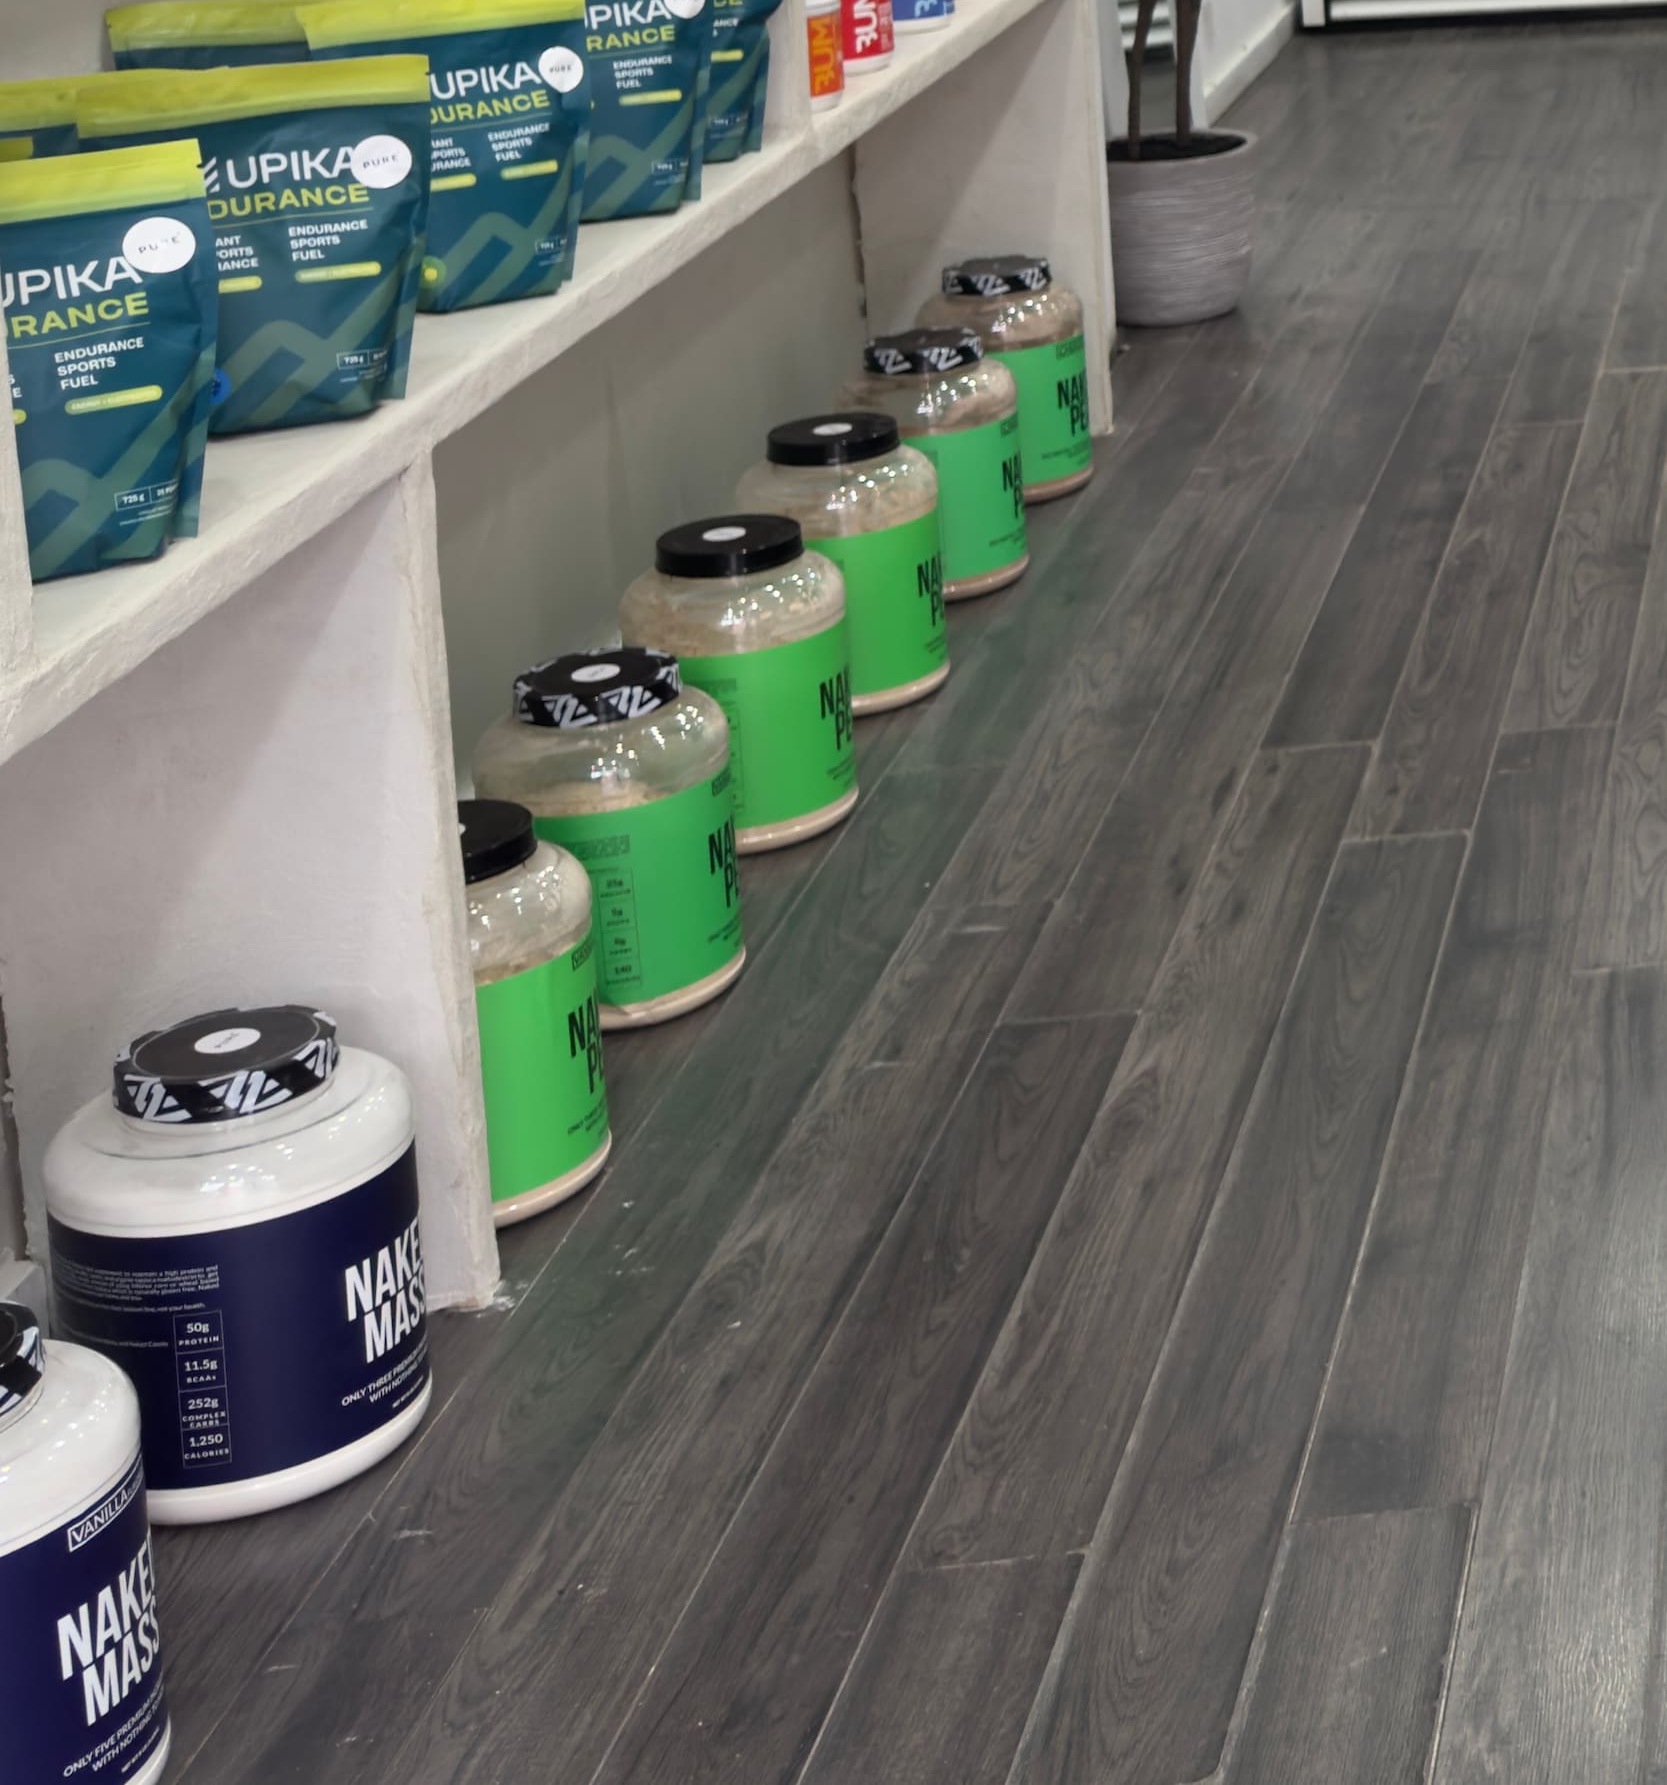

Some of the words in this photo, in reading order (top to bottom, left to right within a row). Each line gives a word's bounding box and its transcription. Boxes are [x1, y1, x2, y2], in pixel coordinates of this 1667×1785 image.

[288, 219, 368, 238] ENDURANCE
[290, 235, 341, 250] SPORTS
[292, 248, 325, 261] FUEL
[54, 336, 145, 364] ENDURANCE
[57, 356, 117, 378] SPORTS
[60, 375, 99, 391] FUEL
[186, 1322, 210, 1334] 50g
[179, 1335, 220, 1346] PROTEIN
[187, 1398, 219, 1410] 252g
[341, 1387, 367, 1406] ONLY
[184, 1448, 230, 1460] CALORIES
[72, 1489, 128, 1544] VANILLA
[63, 1752, 93, 1778] ONLY
[93, 1738, 116, 1760] FIVE
[92, 1748, 120, 1772] WITH
